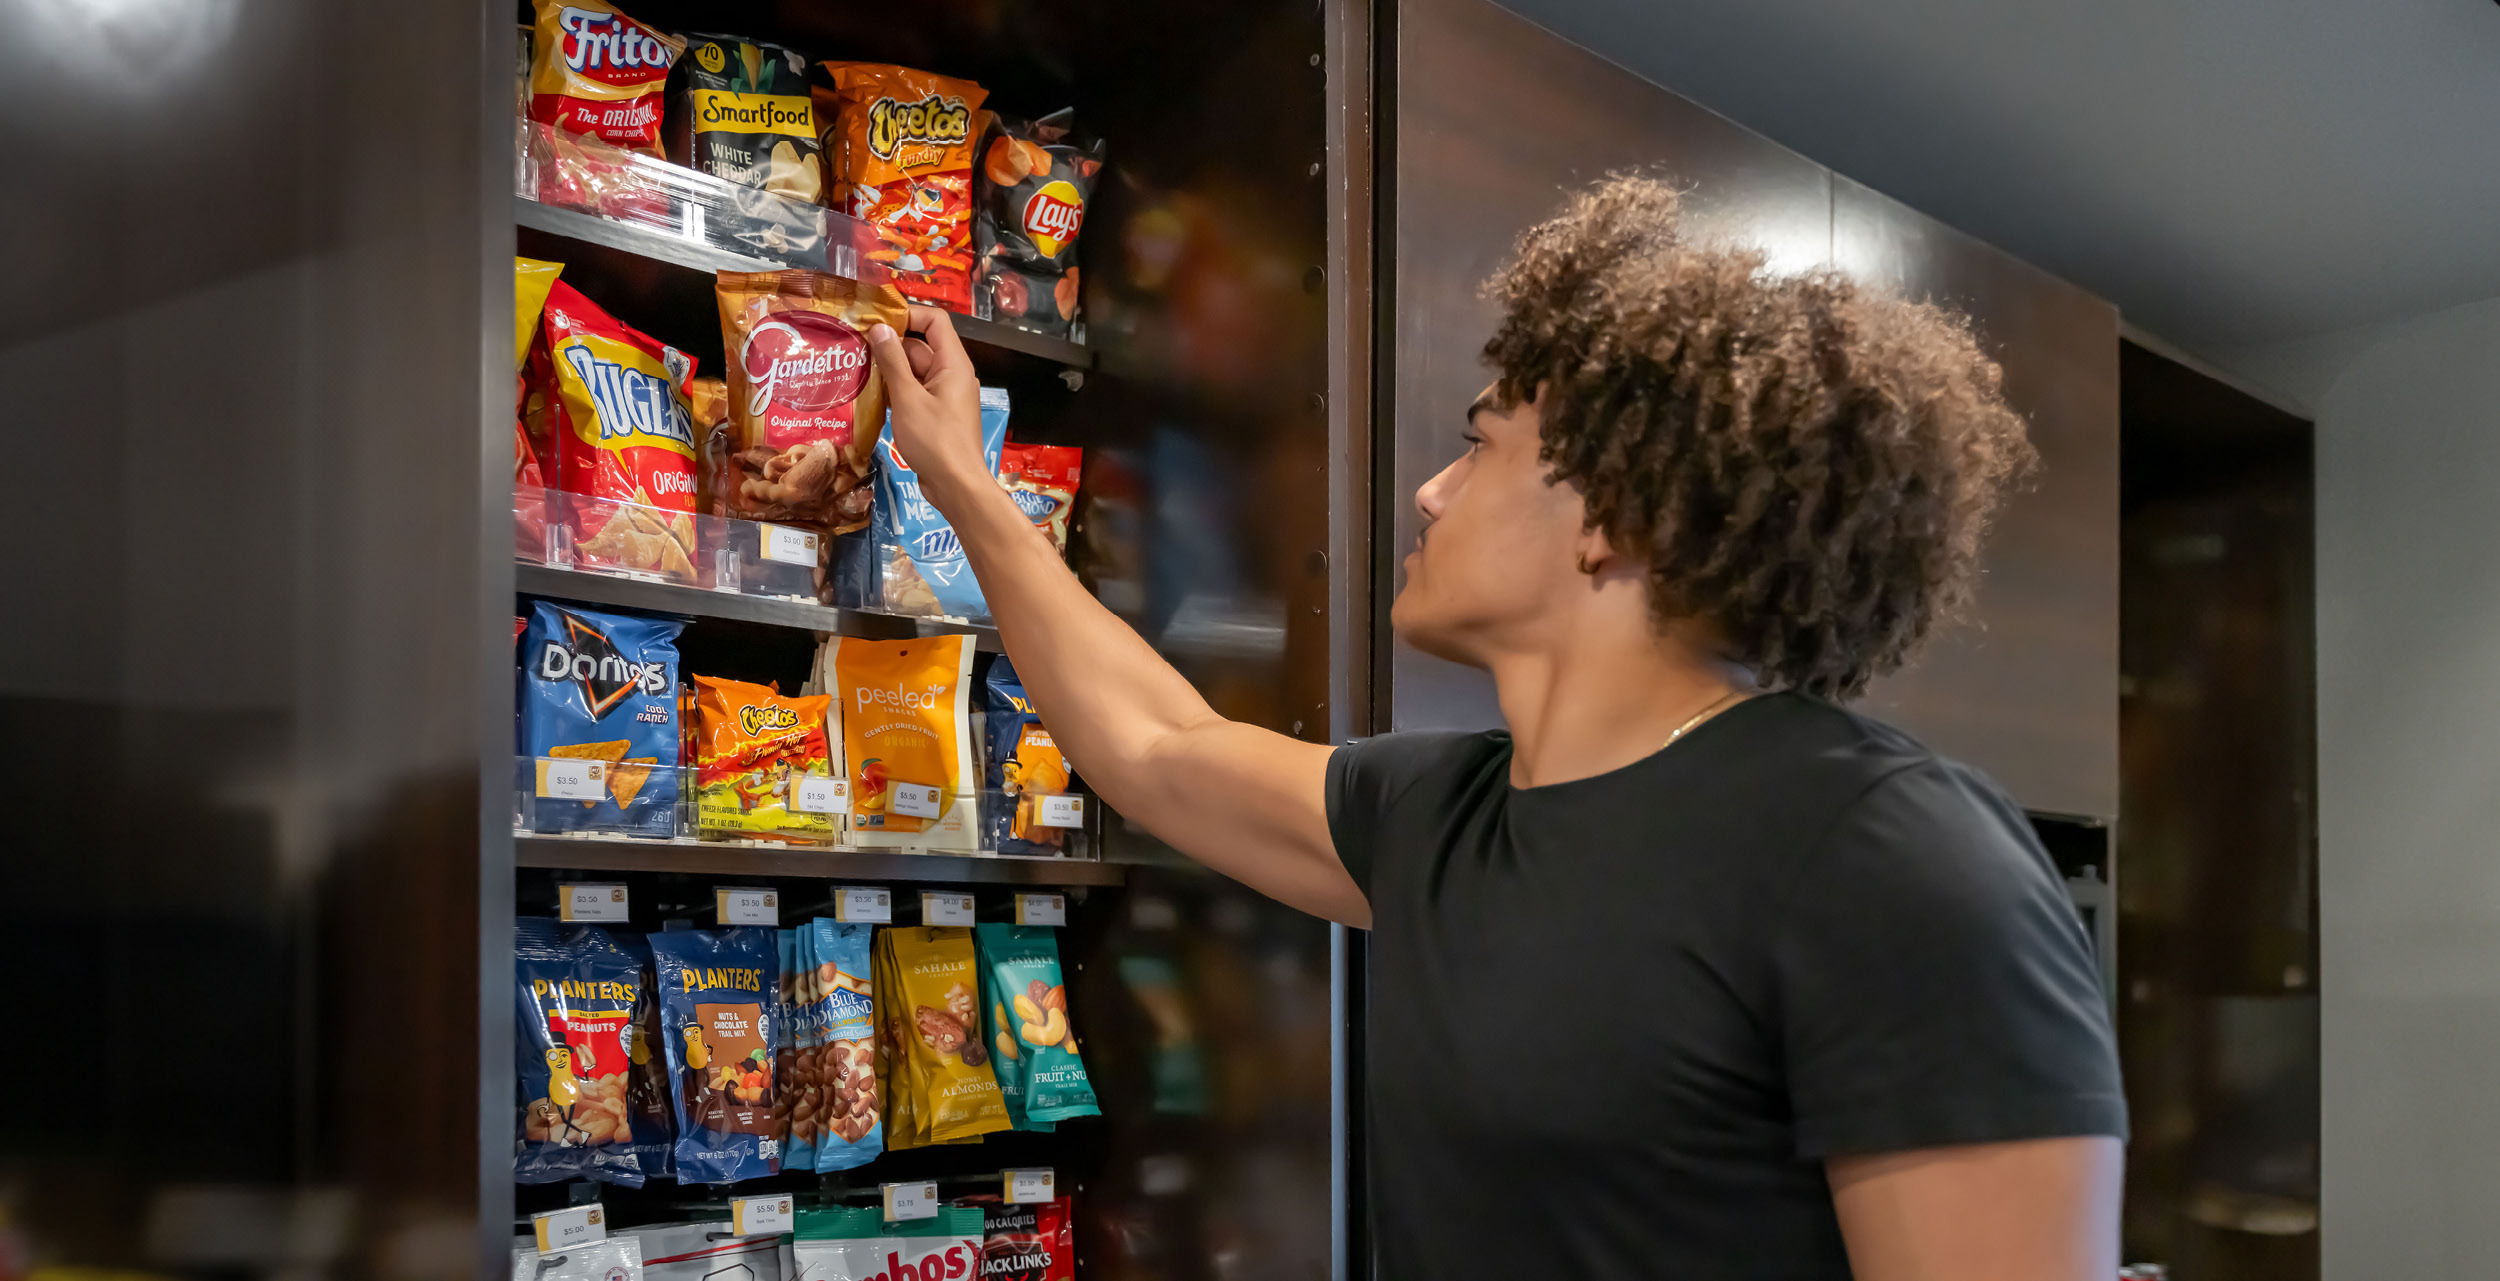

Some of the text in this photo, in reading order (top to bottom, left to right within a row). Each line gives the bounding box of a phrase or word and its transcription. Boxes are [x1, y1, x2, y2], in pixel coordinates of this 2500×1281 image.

[607, 71, 646, 79] BRAND
[576, 102, 658, 127] The ORIGINAL
[703, 95, 809, 128] Smartfood
[605, 129, 645, 138] CORN CHIPS
[868, 95, 971, 159] Cheetos
[710, 142, 752, 166] WHITE
[895, 147, 945, 171] Crunchy
[702, 160, 762, 185] CHEDDAR
[1028, 195, 1081, 241] Lay's
[741, 321, 867, 417] Gardetto's
[564, 345, 696, 449] BUGLES
[770, 415, 848, 431] Original Recipe
[903, 500, 936, 521] ME
[1020, 501, 1056, 515] MOND
[542, 643, 667, 692] Doritos
[856, 682, 936, 714] peeled
[645, 704, 668, 715] COOL
[883, 706, 917, 717] SNACKS
[636, 712, 669, 724] RANCH
[739, 704, 800, 738] Cheetos
[864, 722, 939, 741] GENTLY DRIED FRUIT
[1025, 736, 1057, 748] PEANU
[556, 776, 578, 786] $3.50
[807, 792, 825, 801] $1.50
[900, 791, 917, 800] $5.50
[701, 804, 716, 815] CHEESE
[717, 804, 738, 815] FLAVORED
[651, 811, 671, 824] 260
[741, 899, 760, 907] $3.50
[914, 961, 967, 975] SAHALE
[681, 967, 762, 994] PLANTERS
[534, 979, 637, 1003] PLANTERS
[829, 992, 859, 1007] BLUE
[579, 1011, 600, 1019] SALTED
[717, 1013, 740, 1022] NUTS &
[820, 999, 873, 1025] DIAMOND
[567, 1021, 617, 1034] PEANUTS
[714, 1020, 749, 1030] CHOCOLATE
[831, 1015, 867, 1028] ALMONDS
[718, 1029, 746, 1038] TRAIL MIX
[824, 1028, 854, 1042] Roasted
[1050, 1063, 1078, 1072] CLASSIC
[1034, 1072, 1065, 1084] FRUIT
[1072, 1071, 1088, 1082] NU
[941, 1080, 999, 1098] ALMONDS
[1001, 1084, 1025, 1097] FRUI
[756, 1204, 776, 1214] $5.50
[897, 1199, 914, 1209] $3.75
[984, 1213, 1036, 1230] 00 CALORIES
[563, 1225, 585, 1236] $5.00
[981, 1256, 1014, 1277] JACK
